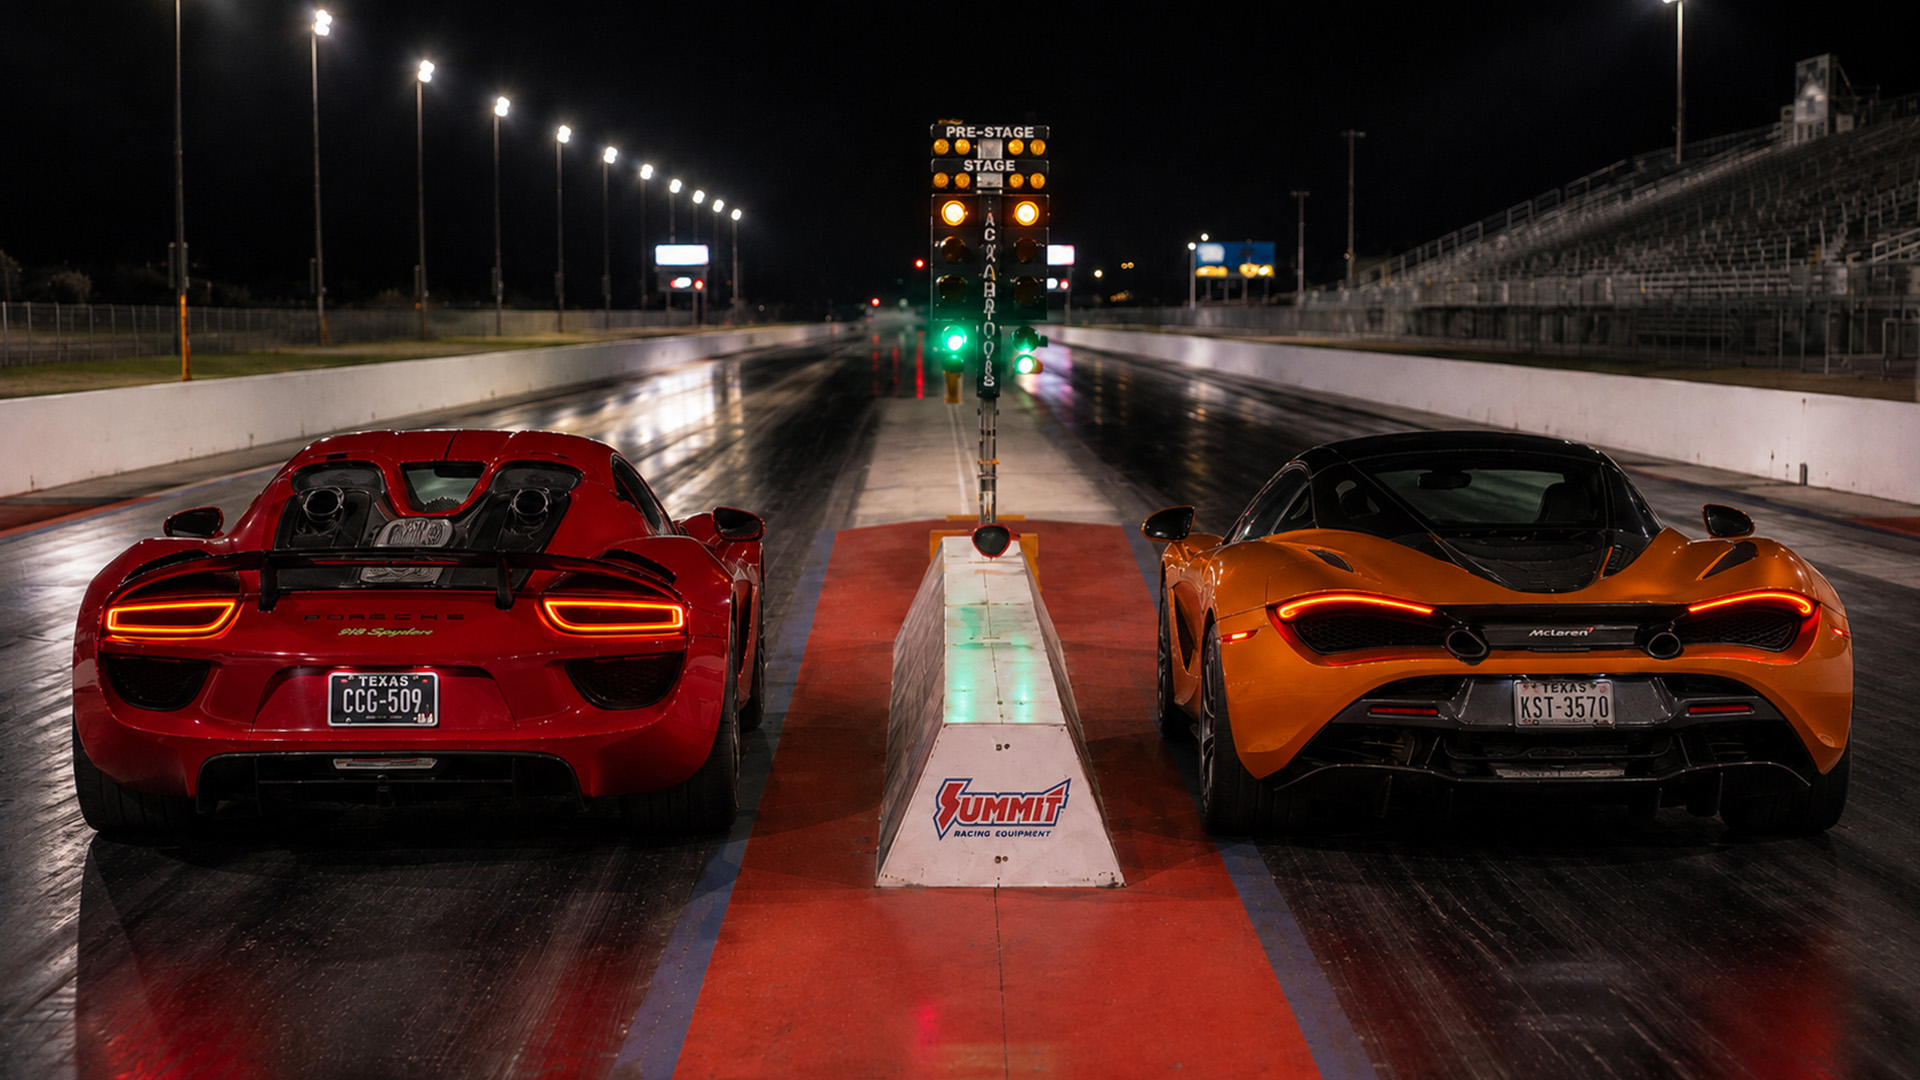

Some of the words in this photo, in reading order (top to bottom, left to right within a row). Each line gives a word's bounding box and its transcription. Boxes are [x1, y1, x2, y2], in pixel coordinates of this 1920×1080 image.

[946, 126, 1035, 138] PRE-STAGE
[963, 159, 1016, 172] STAGE
[338, 627, 367, 636] 918
[1529, 629, 1588, 637] McLaren
[359, 675, 409, 687] TEXAS
[1542, 682, 1587, 693] TEXAS
[343, 688, 422, 713] CCG-509
[1520, 695, 1609, 718] KST-3570
[934, 779, 1070, 839] SUMMIT
[954, 830, 991, 838] RACING
[995, 830, 1051, 838] EQUIPMENT
